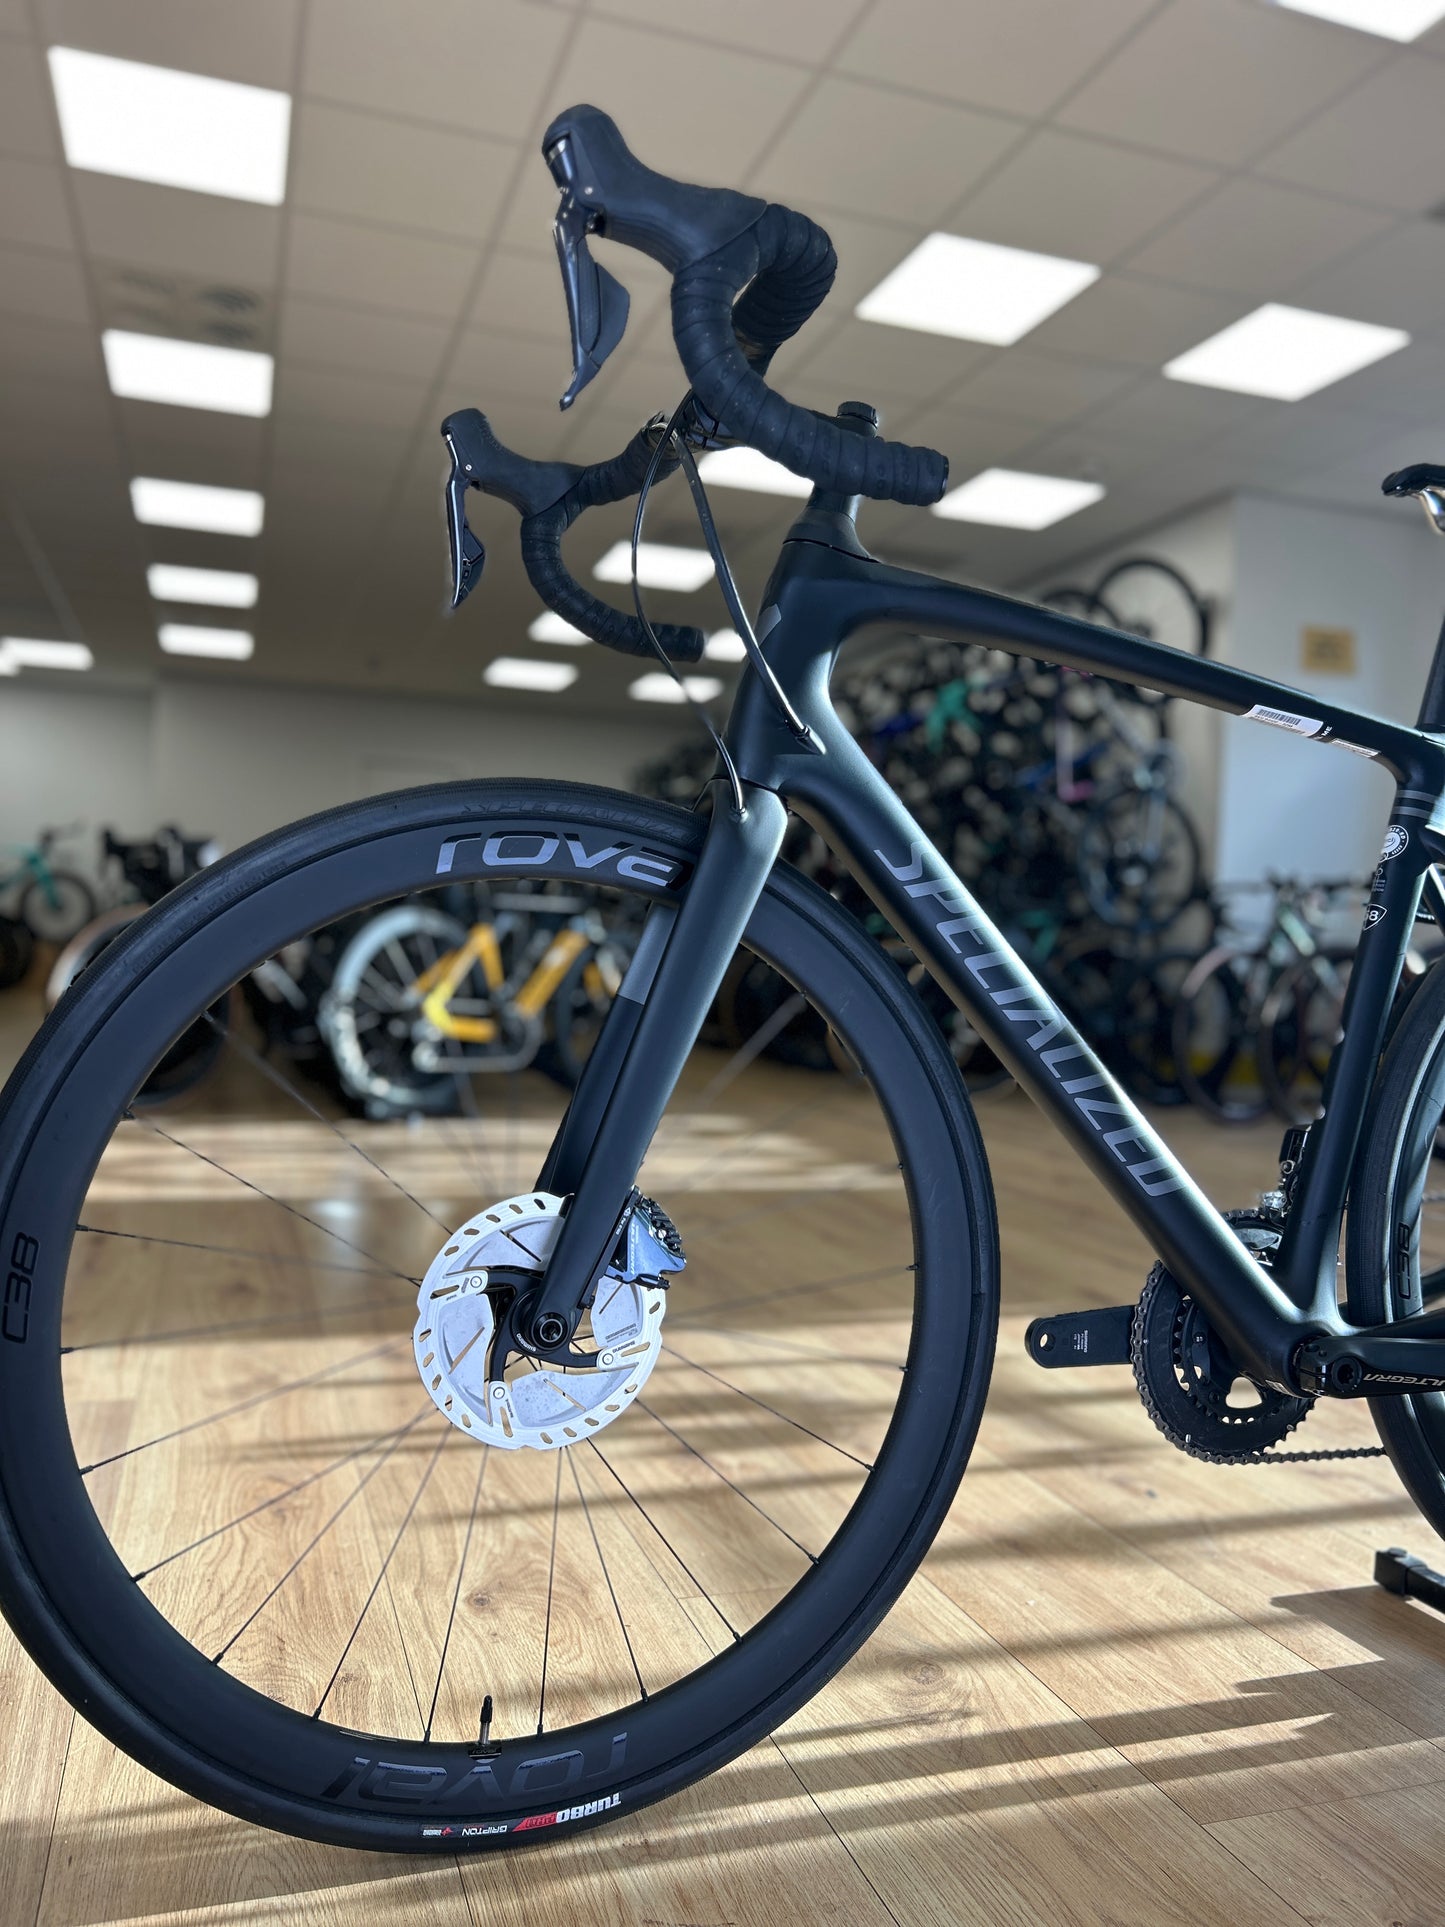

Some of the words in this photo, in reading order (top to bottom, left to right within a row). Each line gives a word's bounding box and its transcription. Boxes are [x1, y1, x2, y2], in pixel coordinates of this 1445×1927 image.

[873, 841, 1193, 1197] SPECIALIZED
[2, 1231, 39, 1344] C38
[1398, 1222, 1411, 1299] C38
[320, 1732, 628, 1805] roval
[461, 1824, 508, 1837] GRIPTON
[556, 1793, 622, 1824] TURBO
